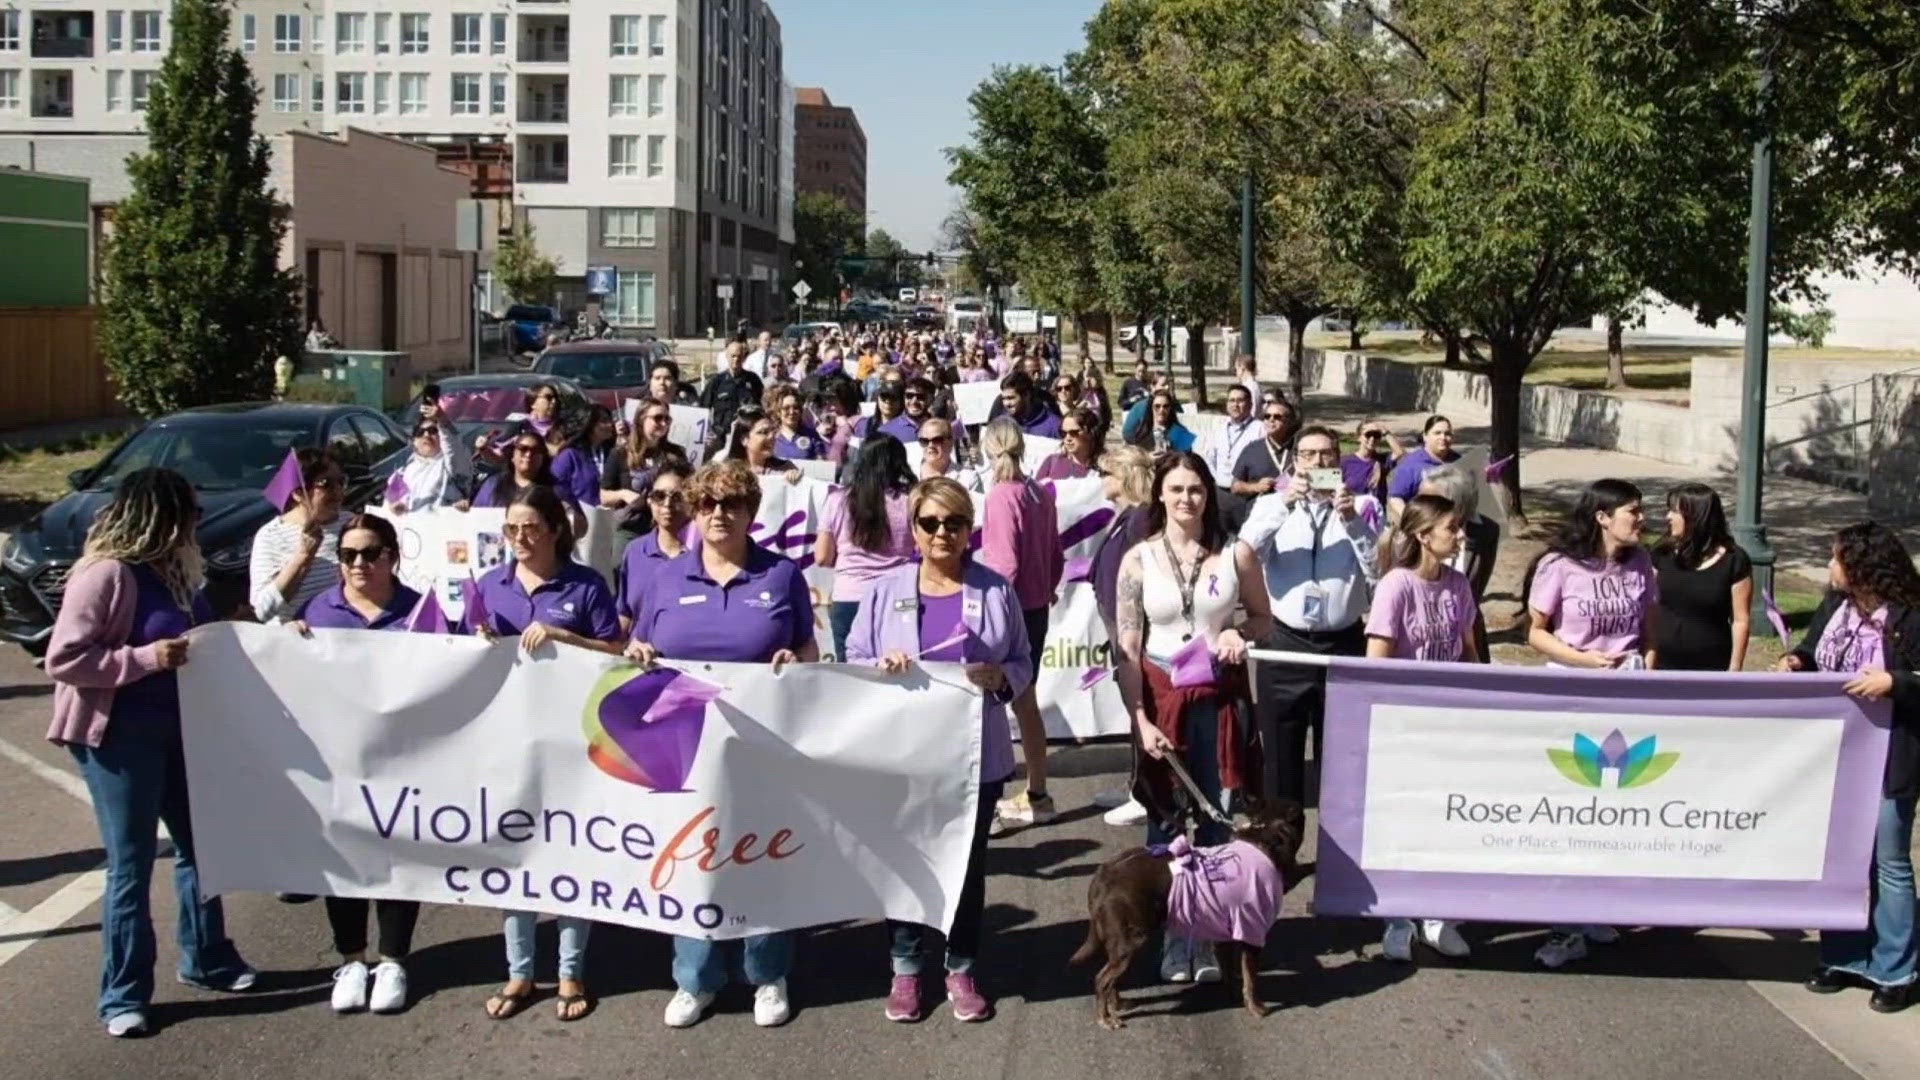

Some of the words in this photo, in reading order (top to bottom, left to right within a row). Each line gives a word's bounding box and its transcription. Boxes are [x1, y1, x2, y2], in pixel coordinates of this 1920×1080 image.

[361, 784, 655, 860] Violence
[1446, 794, 1522, 824] Rose
[1528, 796, 1650, 827] Andom
[1659, 800, 1767, 830] Center
[1481, 833, 1513, 848] One
[1568, 836, 1676, 852] Immeasurable
[650, 806, 805, 891] free
[445, 865, 723, 929] COLORADO
